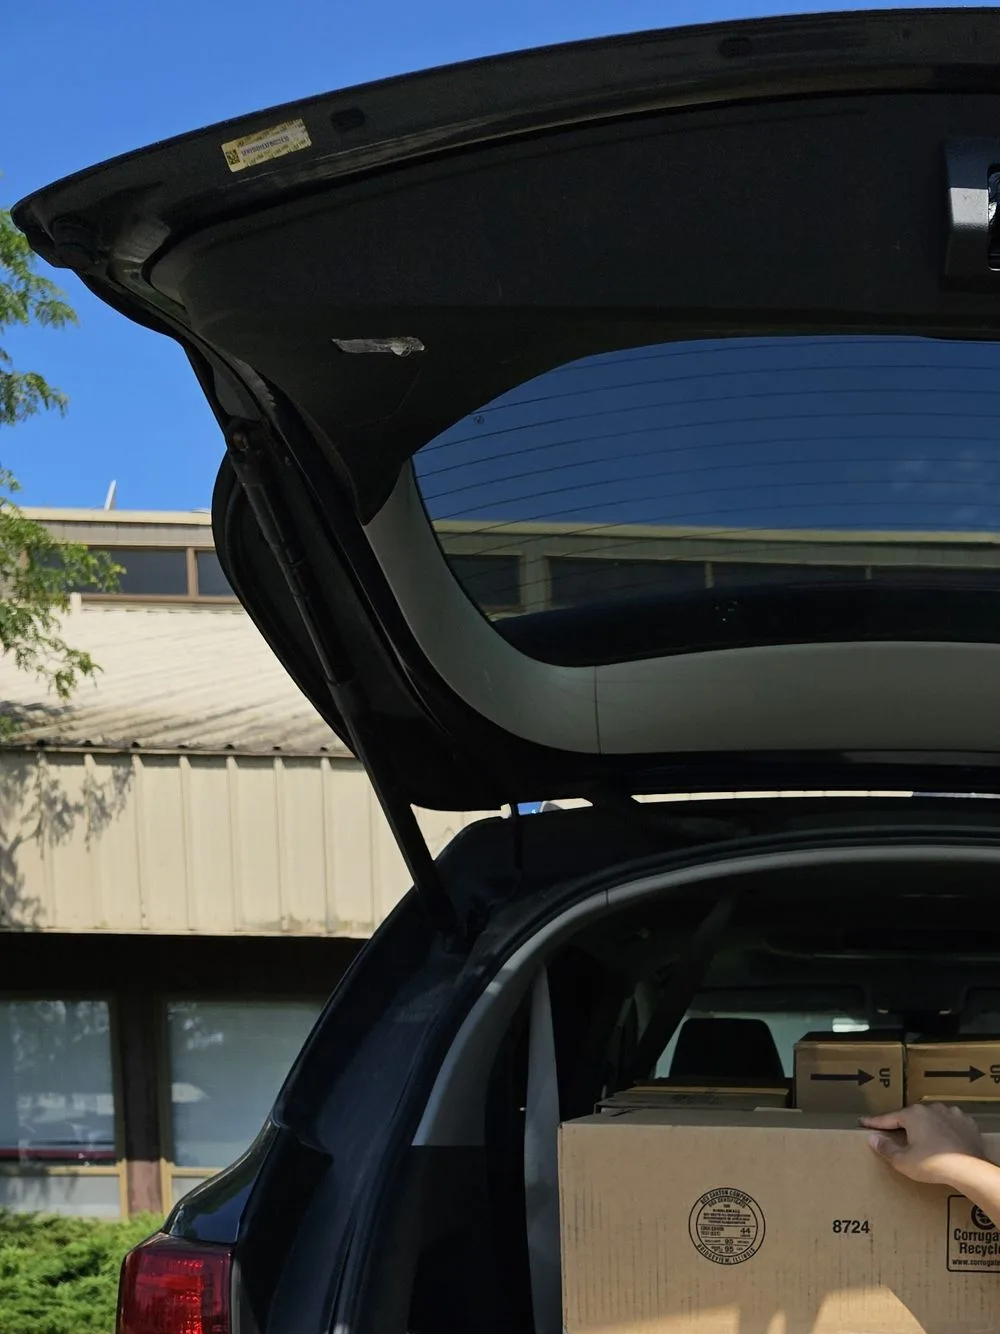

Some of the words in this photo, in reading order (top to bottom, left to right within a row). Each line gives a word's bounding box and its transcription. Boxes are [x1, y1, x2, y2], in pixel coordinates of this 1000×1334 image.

[879, 1068, 890, 1088] UP
[990, 1064, 1000, 1084] UP
[832, 1219, 870, 1233] 8724
